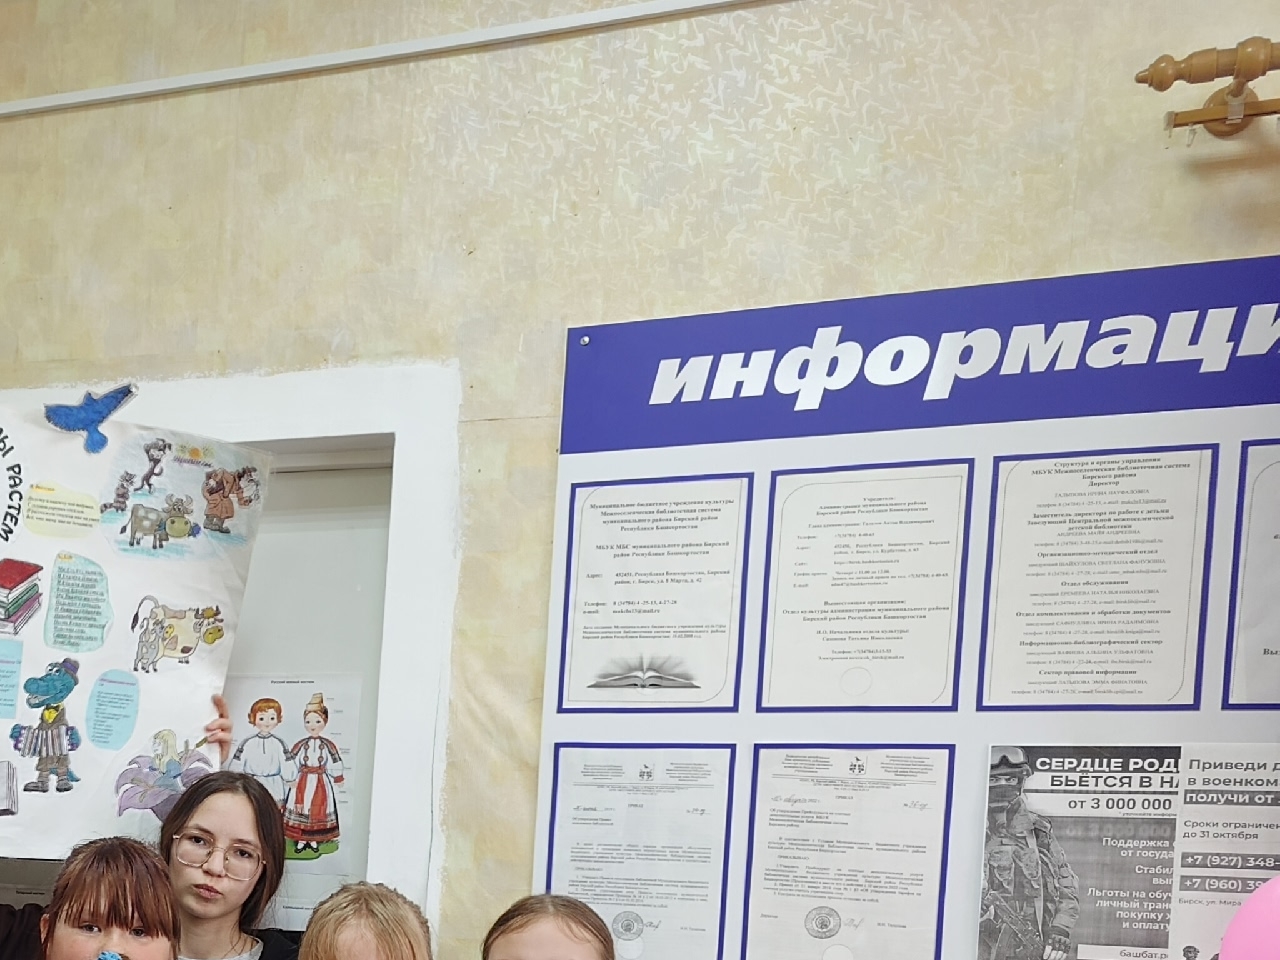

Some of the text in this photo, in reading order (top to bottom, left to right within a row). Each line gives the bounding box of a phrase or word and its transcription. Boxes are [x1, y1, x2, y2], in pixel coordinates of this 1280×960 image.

[1036, 758, 1181, 772] СЕРДЦЕ РОД
[1189, 759, 1267, 772] Приведи
[1050, 773, 1132, 788] БЬЁТСЯ
[1139, 775, 1152, 788] В
[1188, 777, 1196, 786] в
[1068, 798, 1172, 810] от 3 000 000
[1186, 793, 1274, 804] получи от
[1184, 820, 1218, 830] Сроки
[1183, 830, 1258, 840] до 31 октября
[1102, 837, 1169, 849] Поддержка
[1121, 849, 1134, 857] от
[1186, 855, 1202, 865] +7
[1207, 855, 1241, 867] (927)
[1184, 879, 1201, 888] +7
[1205, 878, 1241, 891] (960)
[1087, 888, 1130, 899] Льготы
[1133, 890, 1146, 899] на
[1096, 898, 1140, 909] личный
[1116, 910, 1164, 922] покупку
[1120, 949, 1168, 960] башбат.р
